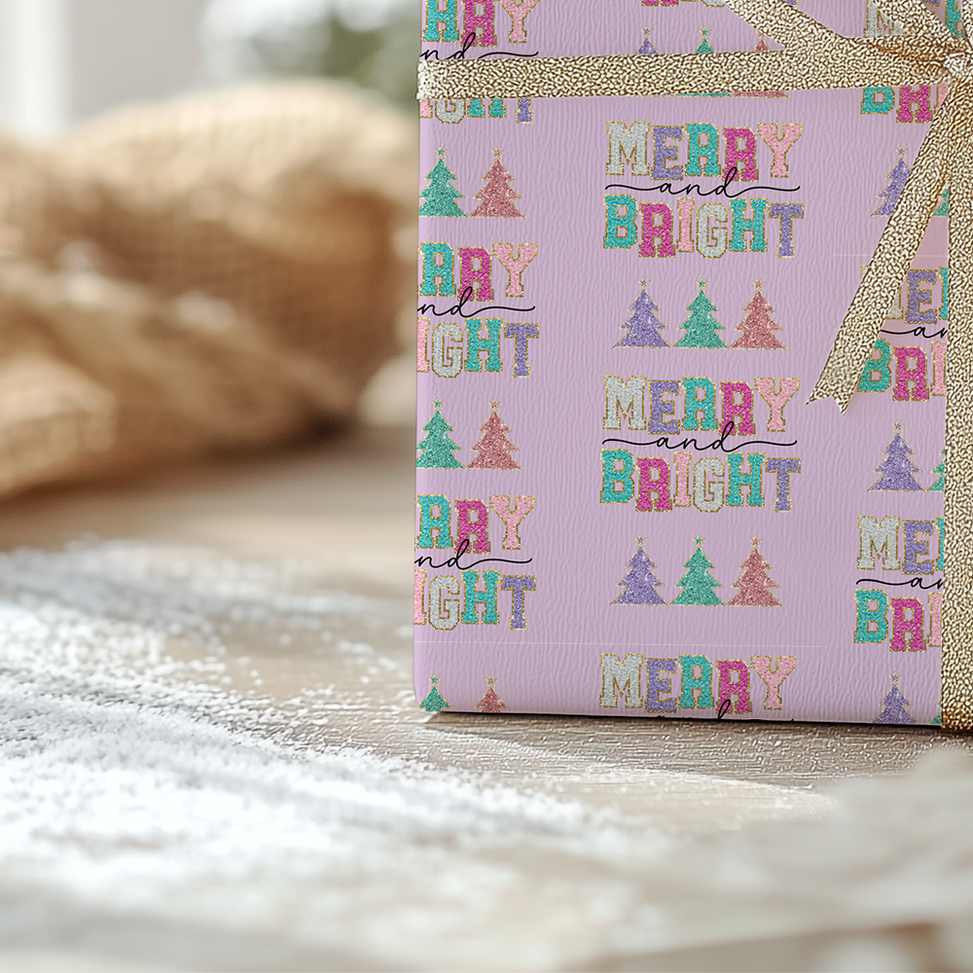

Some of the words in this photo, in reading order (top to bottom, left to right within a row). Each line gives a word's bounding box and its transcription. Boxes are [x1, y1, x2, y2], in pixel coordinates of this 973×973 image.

[420, 32, 539, 60] nd
[606, 122, 803, 182] MERRY
[603, 194, 804, 258] BRIGHT
[419, 242, 538, 302] RRY
[417, 287, 535, 318] nd
[417, 317, 539, 378] IGHT
[603, 376, 800, 436] MERRY
[600, 449, 802, 513] BRIGHT
[414, 539, 533, 569] nd
[416, 494, 535, 554] RRY
[414, 570, 536, 631] IGHT
[600, 654, 797, 714] MERRY
